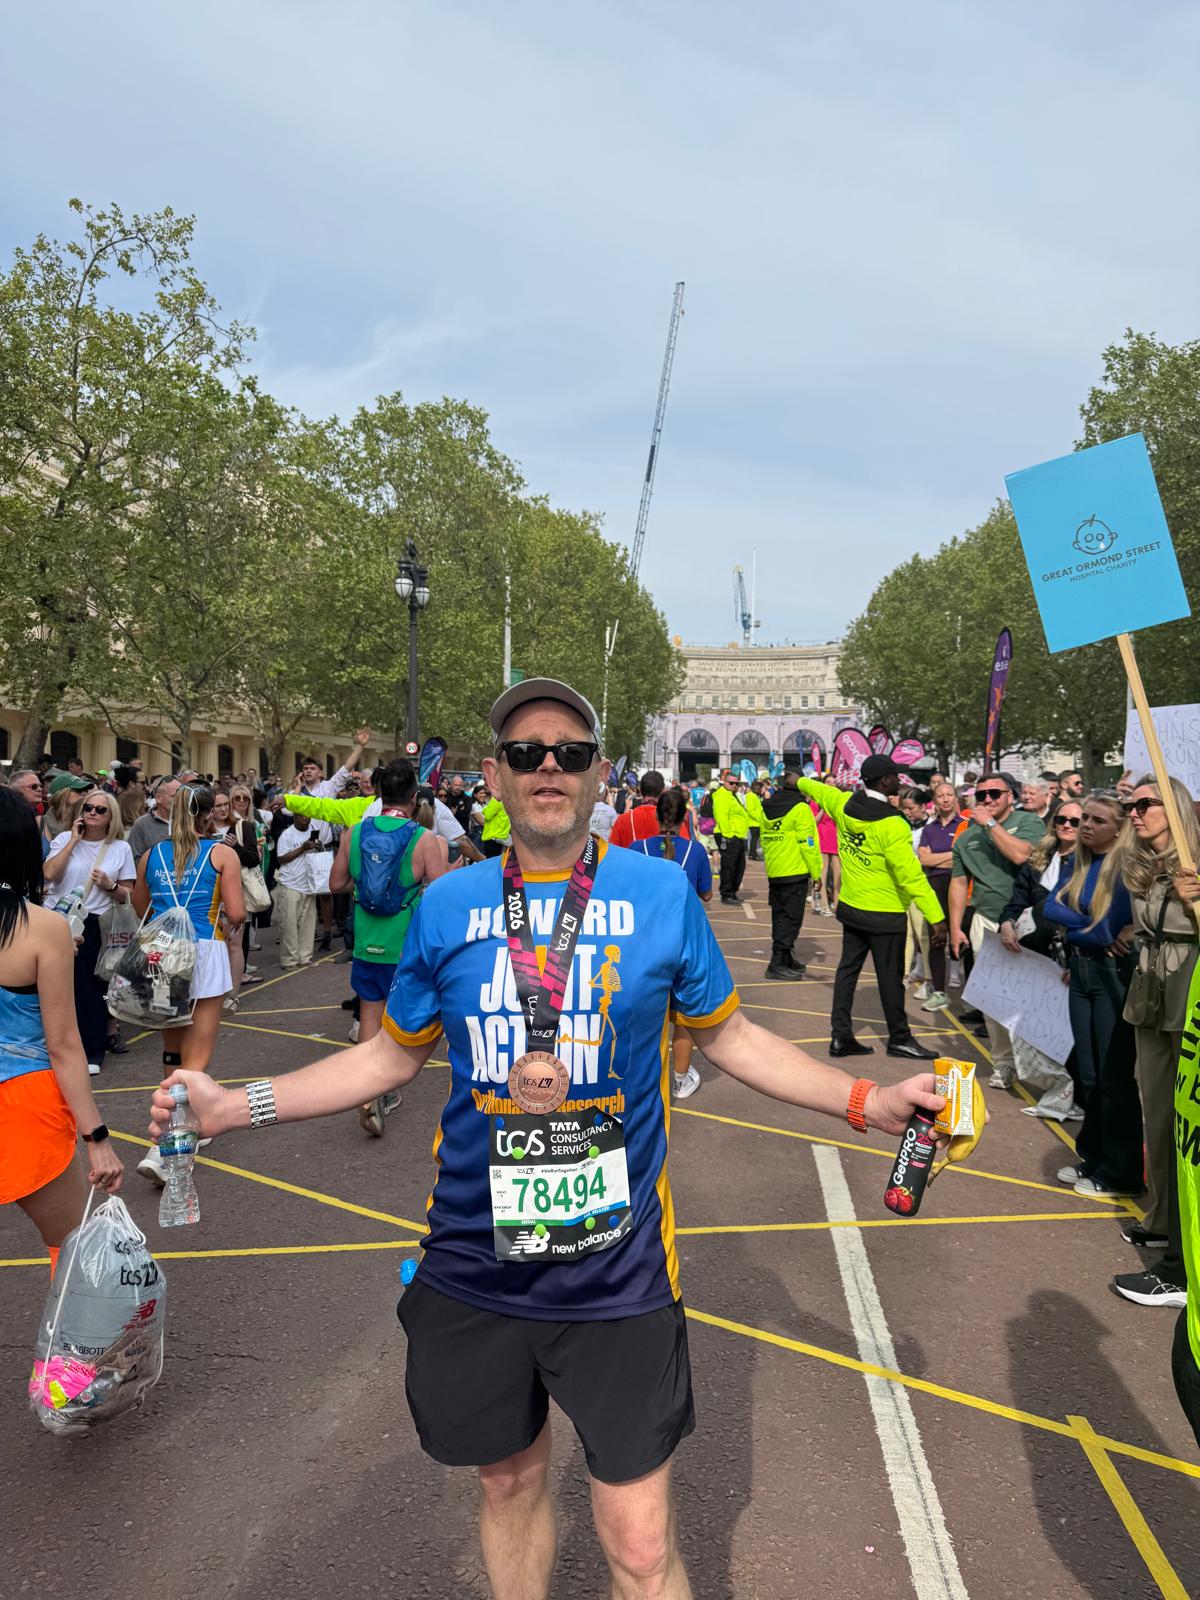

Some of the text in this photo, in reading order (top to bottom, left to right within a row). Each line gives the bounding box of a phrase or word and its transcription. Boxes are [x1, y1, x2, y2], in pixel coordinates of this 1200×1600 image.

[1041, 541, 1161, 582] GREAT ORMOND STREET
[1069, 558, 1137, 582] HOSPITAL CHARITY
[508, 892, 525, 930] 2026
[465, 1013, 601, 1086] ACTON
[496, 1121, 580, 1157] tcs TATA
[550, 1120, 614, 1144] CONSULTANCY
[551, 1138, 592, 1156] SERVICES
[893, 1127, 917, 1185] GetPRO
[511, 1165, 608, 1213] 78494
[552, 1242, 577, 1254] new
[577, 1228, 622, 1251] balance
[120, 1265, 142, 1286] tcs
